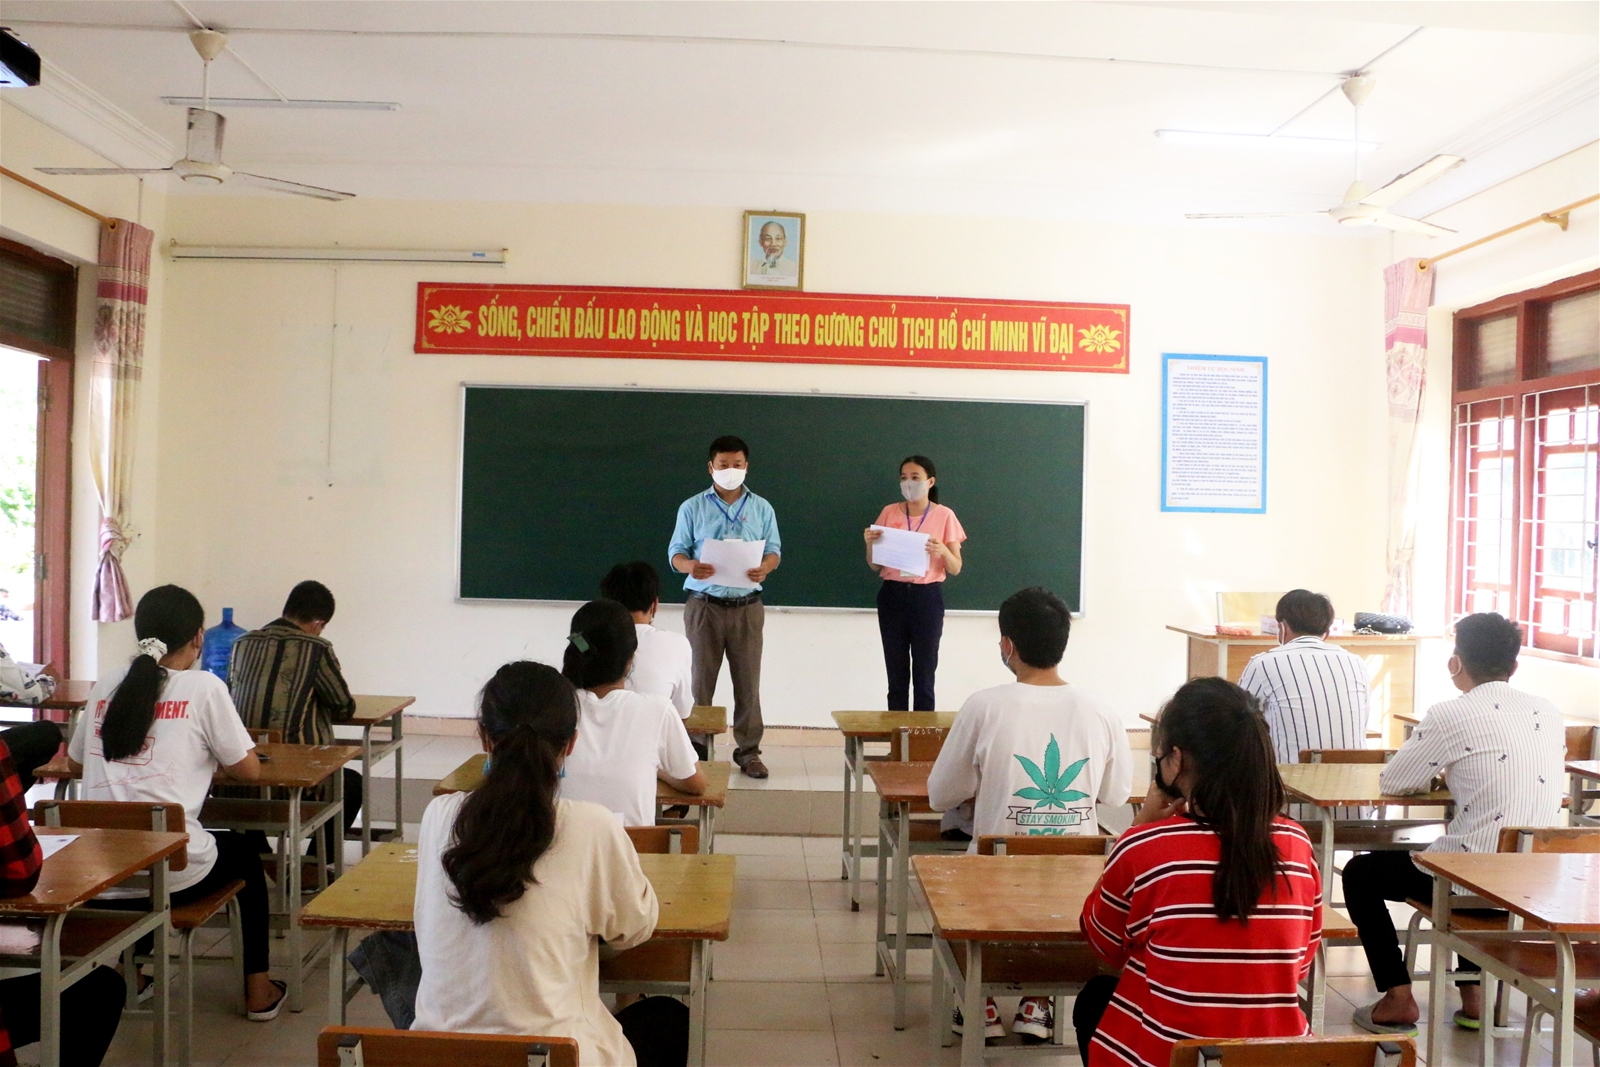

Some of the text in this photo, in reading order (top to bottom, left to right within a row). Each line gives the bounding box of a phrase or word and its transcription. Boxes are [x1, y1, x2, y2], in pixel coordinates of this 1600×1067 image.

[478, 294, 1074, 361] SỐNG, CHIẾN ĐẤU LAO ĐỘNG VÀ HỌC TẬP THEO GƯƠNG CHỦ TỊCH HỒ CHÍ MINH VĨ ĐẠI
[154, 700, 189, 719] MENT.
[1019, 814, 1043, 824] STAY
